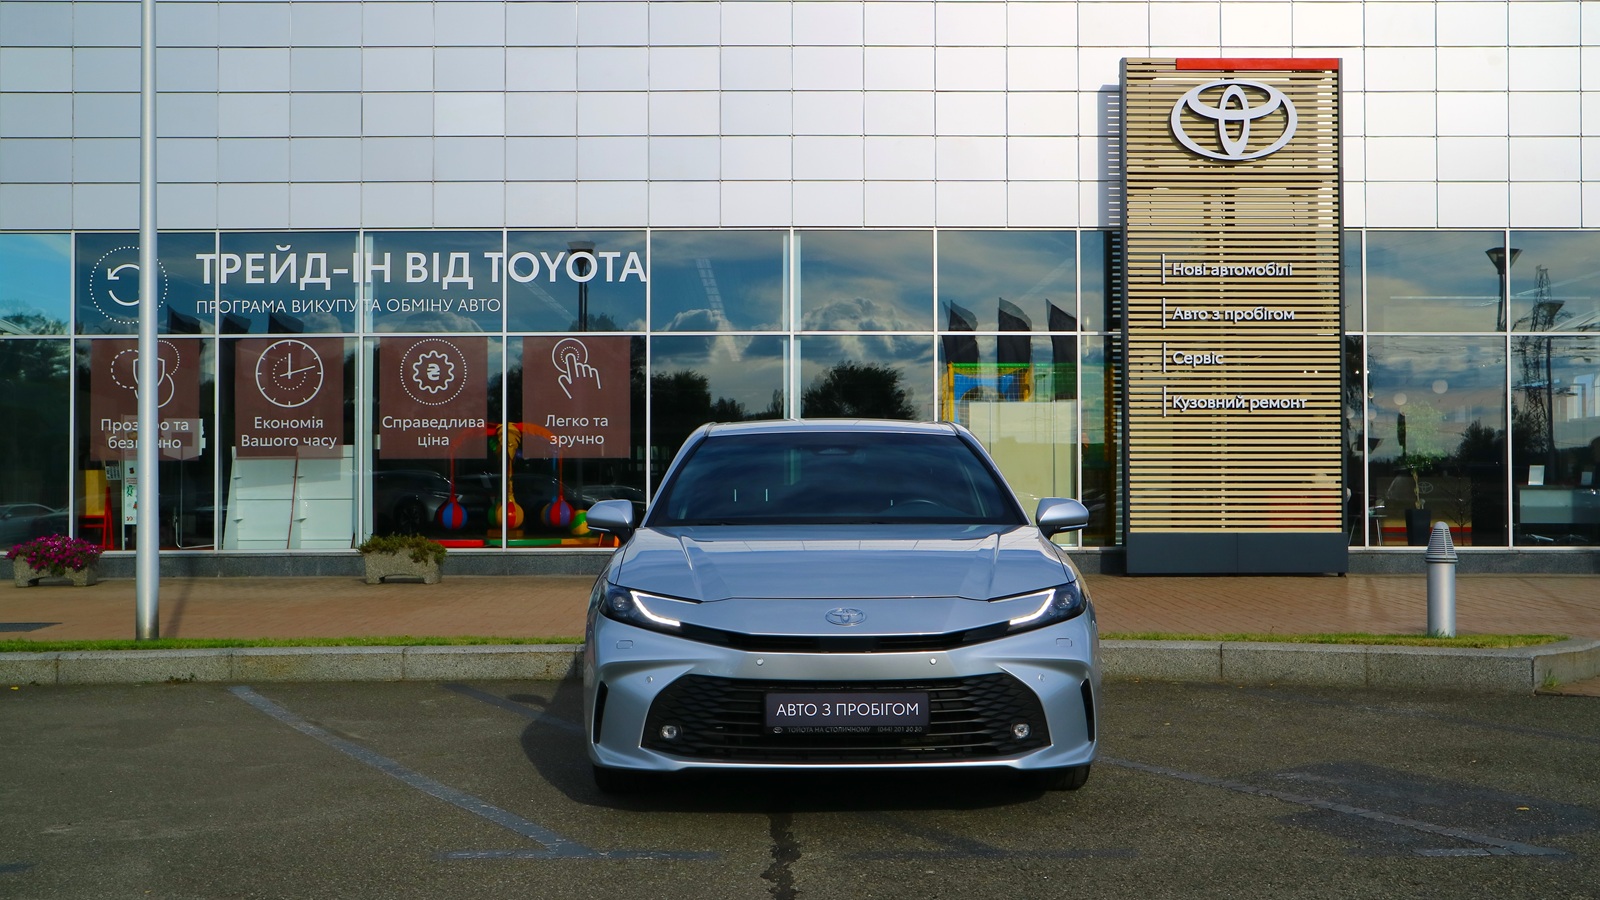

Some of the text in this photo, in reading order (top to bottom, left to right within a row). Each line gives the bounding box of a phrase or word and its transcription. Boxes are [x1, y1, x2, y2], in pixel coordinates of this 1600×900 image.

[195, 244, 647, 291] ТРЕЙД-ІН ВІД TOYOTA
[1172, 261, 1293, 276] Нові автомобілі
[196, 297, 501, 314] ПРОГРАМА ВИКУПУ ТА ОБМІНУ АВТО
[1172, 306, 1295, 324] Авто з пробігом
[1172, 351, 1224, 368] Сервіс
[1172, 395, 1307, 413] Кузовний ремонт
[100, 418, 189, 434] Прозо та
[254, 416, 323, 429] Економія
[382, 415, 485, 431] Справедлива
[545, 414, 609, 427] Легко та
[108, 436, 182, 449] безно
[241, 434, 337, 449] Вашого часу
[417, 434, 450, 447] ціна
[550, 435, 604, 449] зручно
[776, 702, 920, 717] АВТО З ПРОБІГОМ
